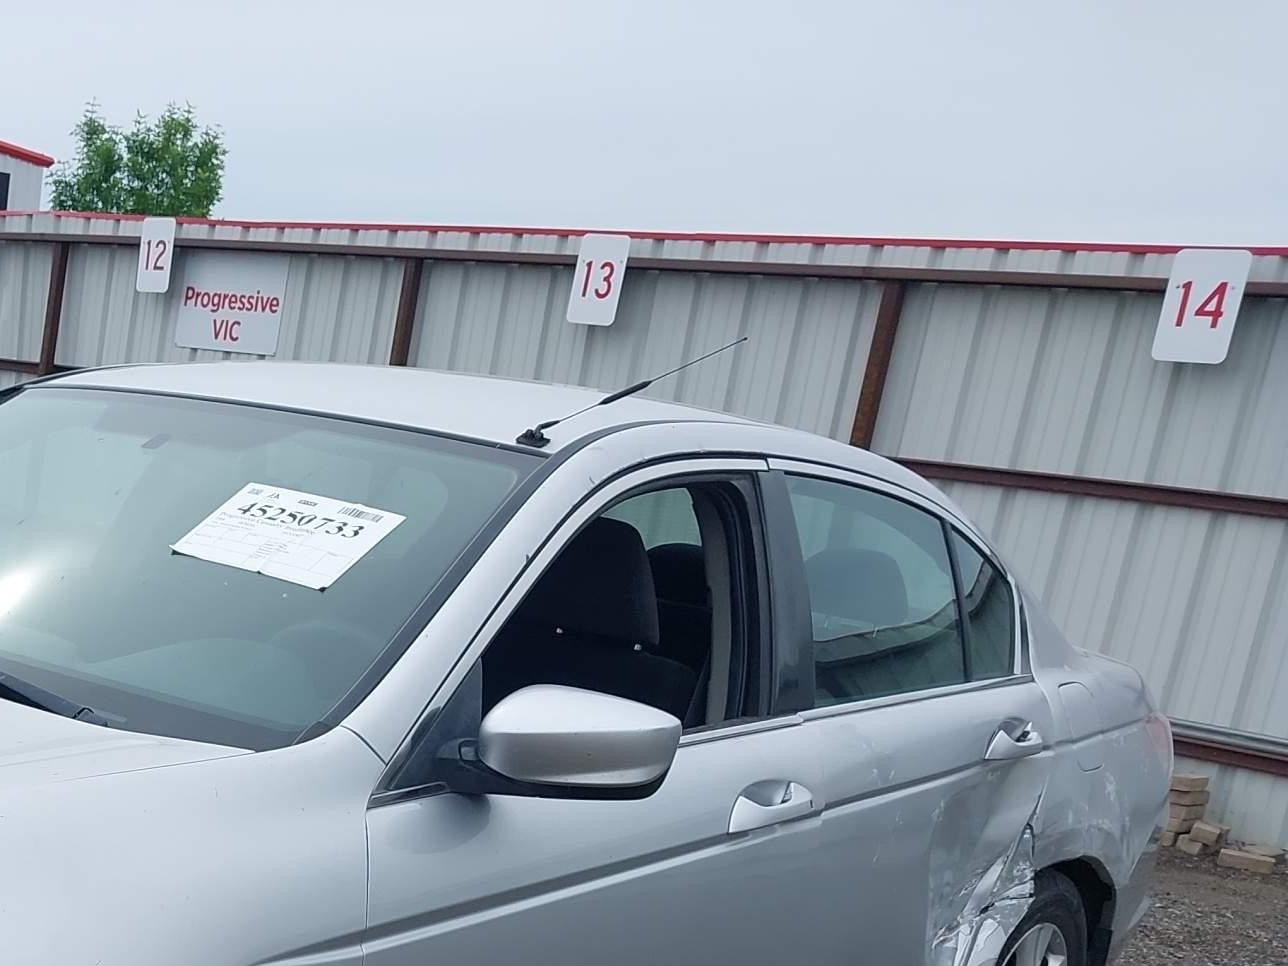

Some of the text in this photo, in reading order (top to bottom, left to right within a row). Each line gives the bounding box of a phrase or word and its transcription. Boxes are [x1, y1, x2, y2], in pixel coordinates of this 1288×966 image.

[145, 239, 167, 271] 12
[582, 260, 615, 299] 13
[183, 286, 280, 315] Progressive
[1175, 280, 1229, 329] 14
[212, 319, 242, 343] VIC
[237, 502, 365, 538] 45250733
